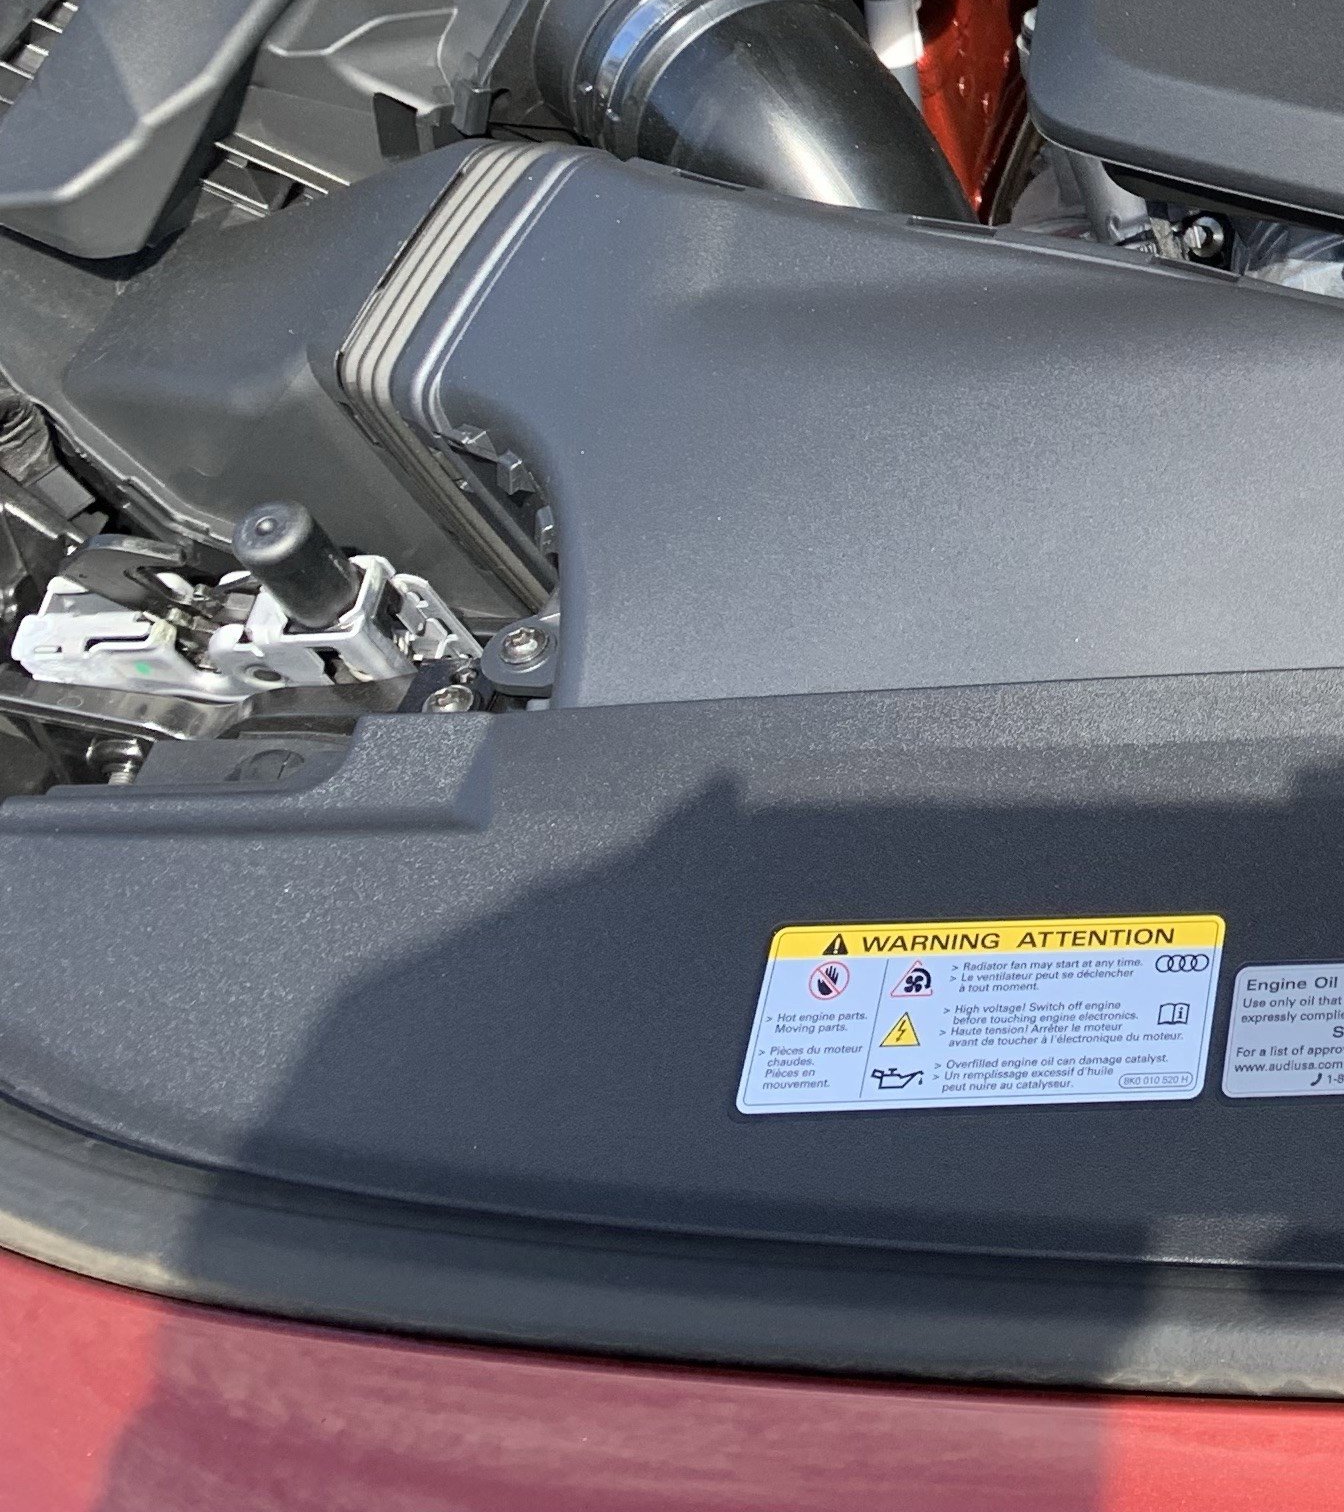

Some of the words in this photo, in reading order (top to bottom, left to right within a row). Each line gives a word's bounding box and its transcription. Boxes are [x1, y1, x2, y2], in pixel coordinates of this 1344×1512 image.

[862, 934, 1000, 953] WARNING
[1016, 928, 1174, 947] ATTENTION
[963, 962, 1008, 971] Radiator
[1010, 960, 1027, 970] fan
[1029, 962, 1053, 970] may
[1055, 960, 1079, 968] start
[1082, 960, 1093, 969] at
[1094, 960, 1116, 971] any
[1117, 958, 1144, 968] time.
[961, 973, 974, 982] Le
[976, 972, 1033, 981] ventilateur
[1035, 971, 1059, 981] peut
[1076, 969, 1134, 978] déclencher
[958, 983, 965, 992] à
[968, 984, 990, 992] tout
[992, 982, 1040, 992] moment.
[1246, 978, 1307, 993] Engine
[1314, 976, 1338, 988] Oil
[954, 1005, 980, 1016] High
[983, 1003, 1026, 1016] voltage!
[1029, 1002, 1065, 1012] Switch
[1067, 1001, 1083, 1011] off
[1084, 1001, 1121, 1014] engine
[1243, 998, 1266, 1008] Use
[1269, 997, 1296, 1008] only
[1299, 996, 1315, 1006] oil
[1318, 996, 1342, 1005] that
[776, 1014, 796, 1023] Hot
[798, 1012, 835, 1025] engine
[837, 1012, 867, 1024] parts.
[952, 1016, 987, 1026] before
[990, 1014, 1037, 1026] touching
[1039, 1014, 1076, 1026] engine
[1078, 1012, 1138, 1024] electronics.
[1241, 1011, 1297, 1024] expressly
[774, 1024, 816, 1034] Moving
[817, 1024, 847, 1034] parts.
[950, 1027, 982, 1036] Haute
[985, 1024, 1029, 1035] tension!
[1030, 1024, 1069, 1034] Arrêter
[1071, 1023, 1081, 1032] le
[1083, 1023, 1123, 1032] moteur
[948, 1038, 978, 1047] avant
[980, 1036, 995, 1046] de
[997, 1036, 1038, 1045] toucher
[1040, 1035, 1047, 1044] à
[1050, 1034, 1123, 1044] l'électronique
[1125, 1032, 1140, 1042] du
[1142, 1032, 1183, 1041] moteur.
[769, 1046, 804, 1055] Pièces
[806, 1045, 821, 1054] du
[823, 1045, 863, 1054] moteur
[1236, 1047, 1256, 1057] For
[1259, 1048, 1266, 1056] a
[1270, 1046, 1288, 1056] list
[1291, 1045, 1305, 1056] of
[767, 1057, 814, 1070] chaudes.
[945, 1059, 999, 1070] Overfilled
[1001, 1058, 1038, 1069] engine
[1040, 1057, 1054, 1066] oil
[1056, 1058, 1076, 1067] can
[1078, 1056, 1122, 1069] damage
[1124, 1054, 1169, 1066] catalyst.
[1234, 1060, 1343, 1072] www.audiusa.com
[764, 1068, 799, 1078] Pièces
[802, 1069, 816, 1077] en
[944, 1071, 960, 1080] Un
[962, 1070, 1028, 1082] remplissage
[1031, 1067, 1075, 1079] excessif
[1076, 1066, 1114, 1076] d'huile
[762, 1079, 830, 1089] mouvement.
[941, 1083, 966, 1093] peut
[969, 1080, 997, 1091] nuire
[999, 1082, 1013, 1090] au
[1015, 1080, 1073, 1090] catalyseur.
[1123, 1076, 1141, 1086] 8K0
[1142, 1076, 1160, 1086] 010
[1161, 1075, 1180, 1086] 520
[1180, 1074, 1190, 1084] H
